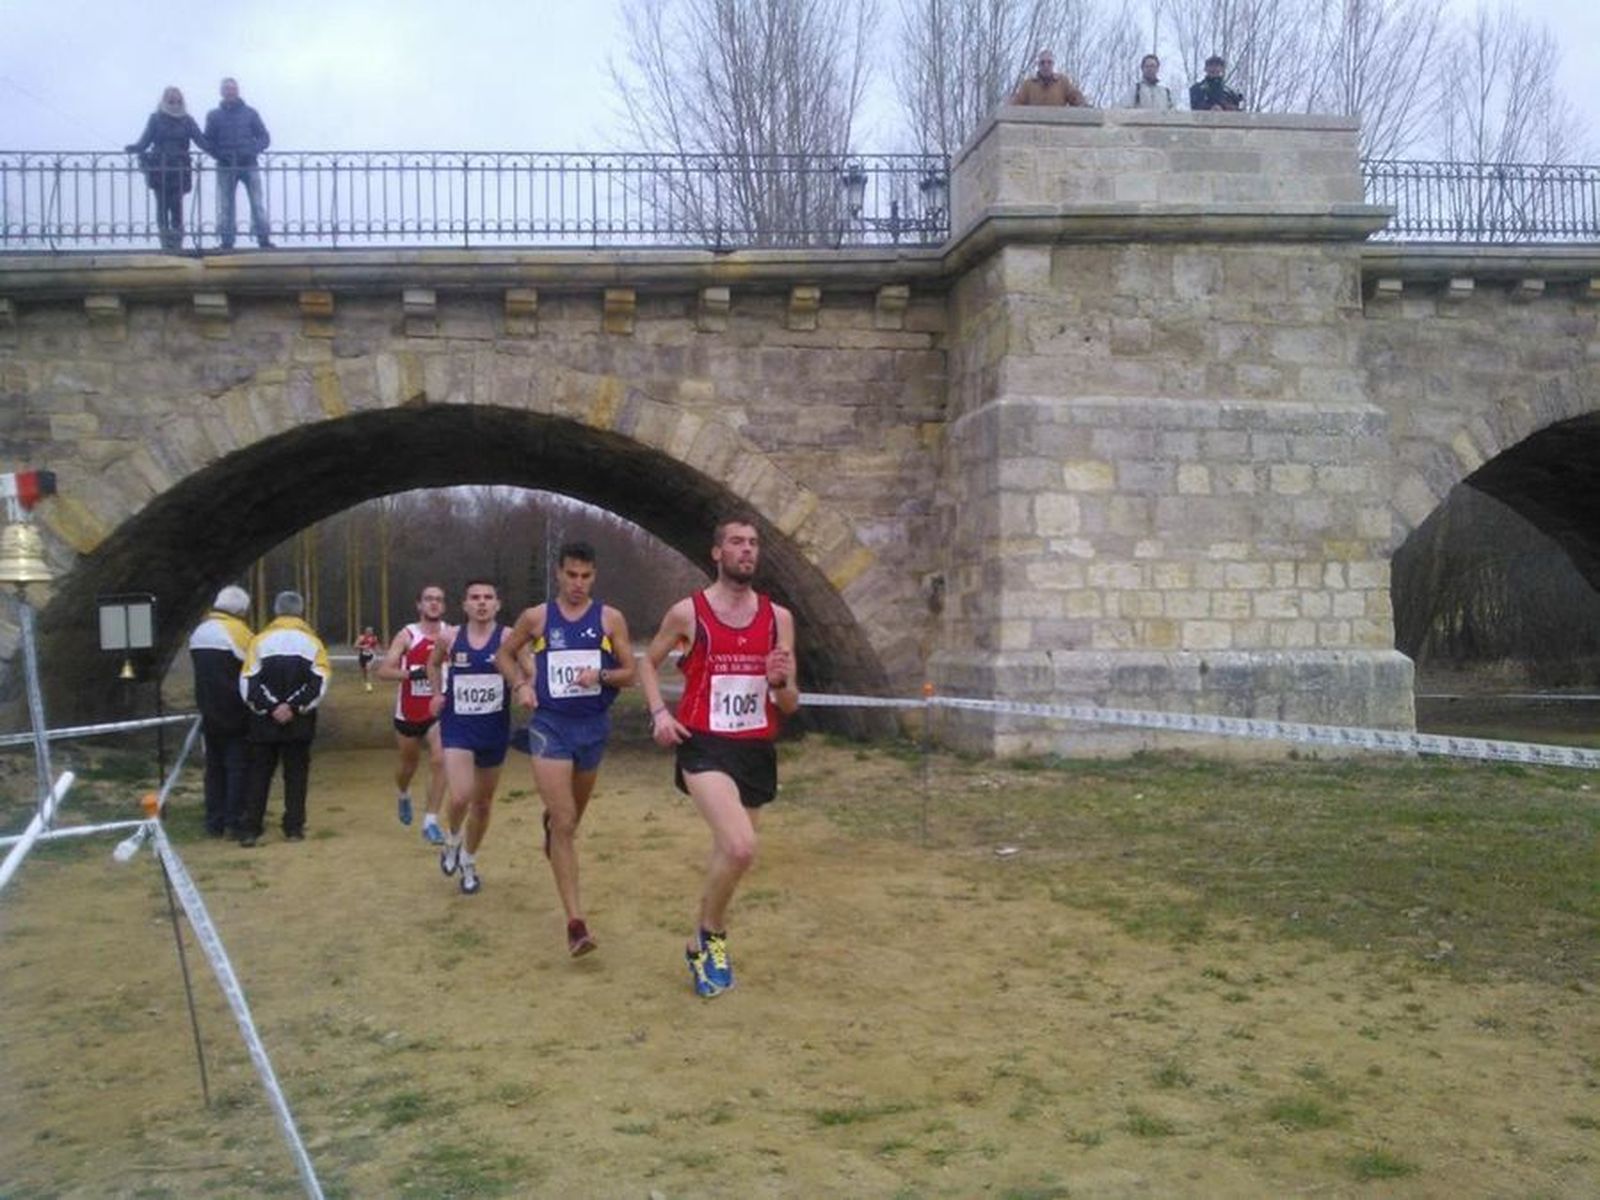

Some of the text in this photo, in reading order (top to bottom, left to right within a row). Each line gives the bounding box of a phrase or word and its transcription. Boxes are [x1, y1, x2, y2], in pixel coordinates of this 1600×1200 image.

[556, 665, 592, 685] 102
[463, 687, 496, 704] 1026
[722, 692, 758, 716] 1005
